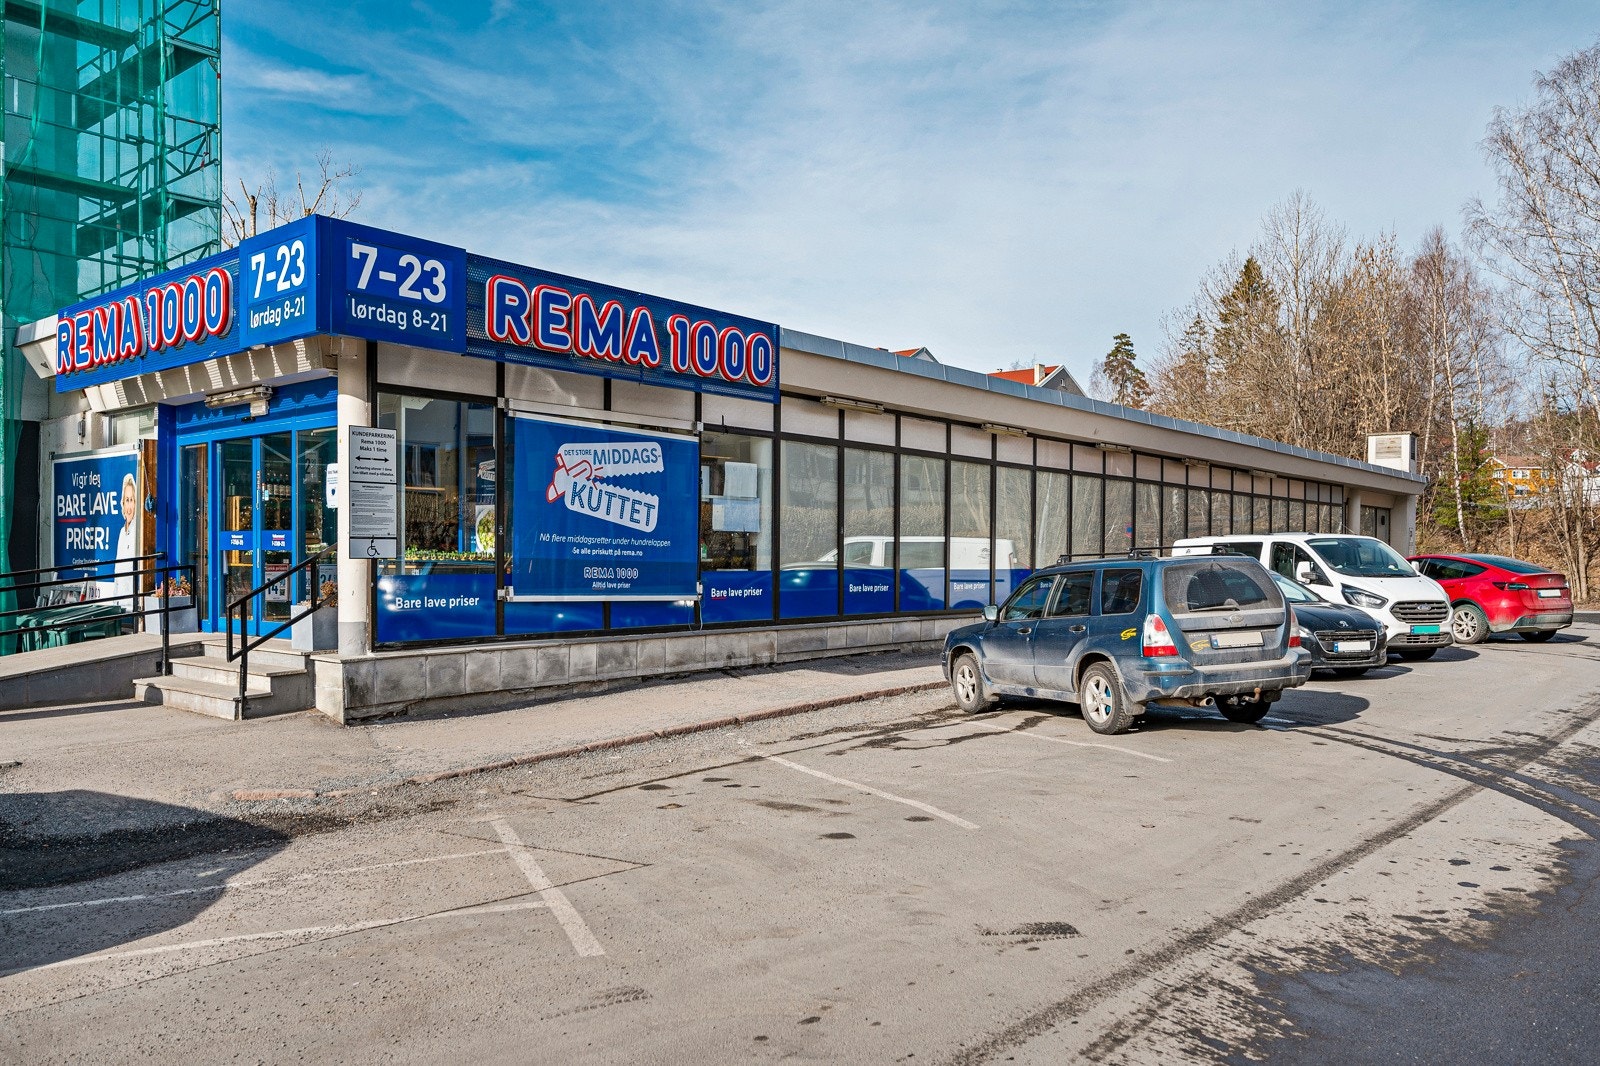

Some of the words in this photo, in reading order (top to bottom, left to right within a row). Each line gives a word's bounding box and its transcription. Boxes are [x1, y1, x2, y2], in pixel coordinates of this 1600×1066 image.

[251, 239, 306, 298] 7-23
[351, 243, 447, 303] 7-23
[56, 296, 145, 375] REMA
[147, 267, 232, 352] 1000
[250, 305, 282, 329] lørdag
[283, 295, 306, 326] 8-21
[351, 297, 408, 331] lørdag
[412, 309, 448, 333] 8-21
[485, 274, 661, 369] REMA
[666, 313, 774, 387] 1000
[352, 431, 394, 439] KUNDEPARKERING
[564, 449, 574, 457] DET
[575, 448, 592, 456] STORE
[592, 447, 662, 466] MIDDAGS-
[71, 472, 79, 487] Vi
[79, 473, 88, 490] gir
[89, 470, 101, 488] deg
[57, 493, 87, 517] BARE
[88, 491, 119, 515] LAVE
[570, 481, 656, 527] KUTTET
[66, 526, 110, 551] PRISER!
[539, 533, 551, 543] Nå
[551, 533, 566, 543] flere
[567, 534, 612, 546] middagsretter
[612, 536, 630, 545] under
[630, 537, 671, 548] hundrelappen
[580, 547, 592, 555] alle
[591, 547, 614, 557] priskutt
[614, 547, 621, 557] på
[621, 549, 643, 557] rema.no
[583, 566, 614, 579] REMA
[616, 567, 639, 579] 1000
[592, 581, 606, 589] Alltid
[616, 582, 631, 590] priser
[711, 588, 727, 598] Bare
[728, 587, 743, 597] lave
[743, 586, 763, 598] priser
[849, 584, 861, 593] Bare
[861, 584, 873, 592] lave
[874, 584, 889, 593] priser
[973, 582, 986, 591] priser
[395, 597, 422, 610] Bare
[424, 596, 446, 608] lave
[450, 595, 480, 608] priser
